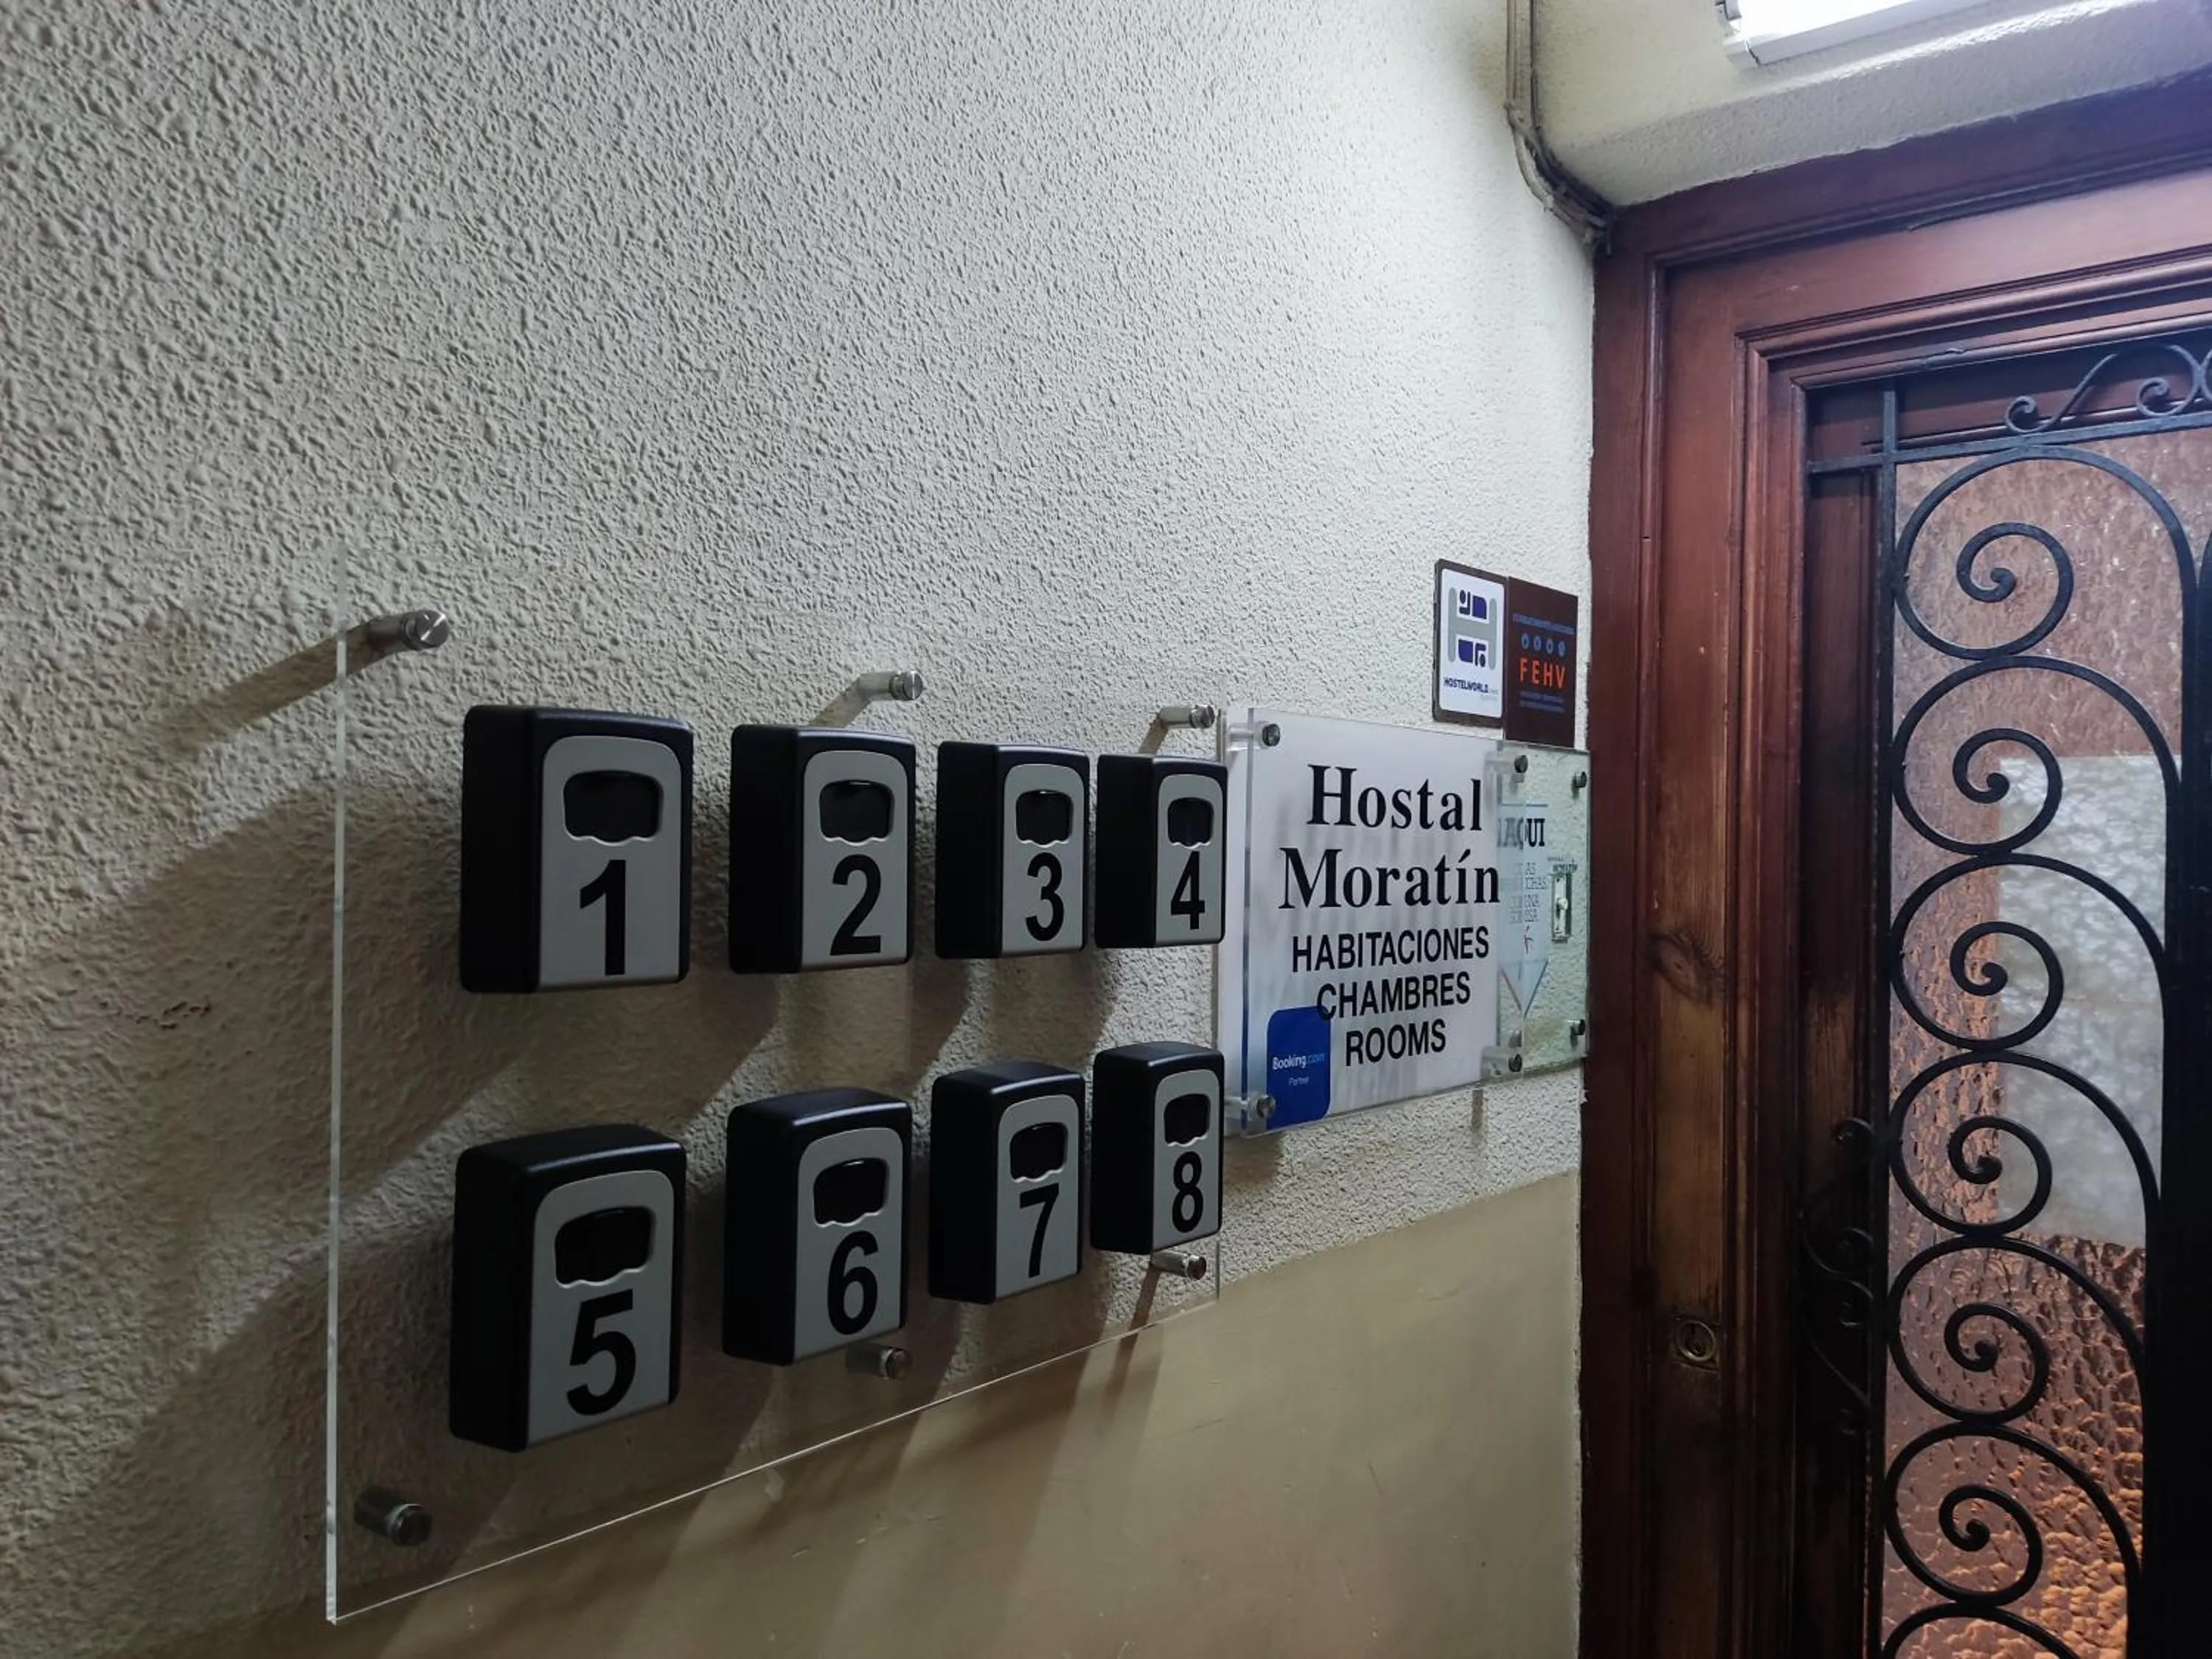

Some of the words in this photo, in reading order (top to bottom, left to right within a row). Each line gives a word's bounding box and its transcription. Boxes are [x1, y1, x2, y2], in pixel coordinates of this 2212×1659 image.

[1520, 658, 1565, 689] FEHV
[1306, 764, 1483, 832] Hostal
[580, 859, 626, 976] 1
[830, 854, 882, 956] 2
[1025, 852, 1065, 942] 3
[1170, 850, 1206, 931] 4
[1278, 847, 1500, 909] Moratín
[1292, 925, 1489, 973] HABITACIONES
[1316, 971, 1471, 1020] CHAMBRES
[1273, 1053, 1325, 1070] Booking.com
[1346, 1018, 1446, 1067] ROOMS
[1019, 1182, 1060, 1279] 7
[1172, 1151, 1204, 1234] 8
[827, 1230, 879, 1335] 6
[566, 1288, 636, 1416] 5
